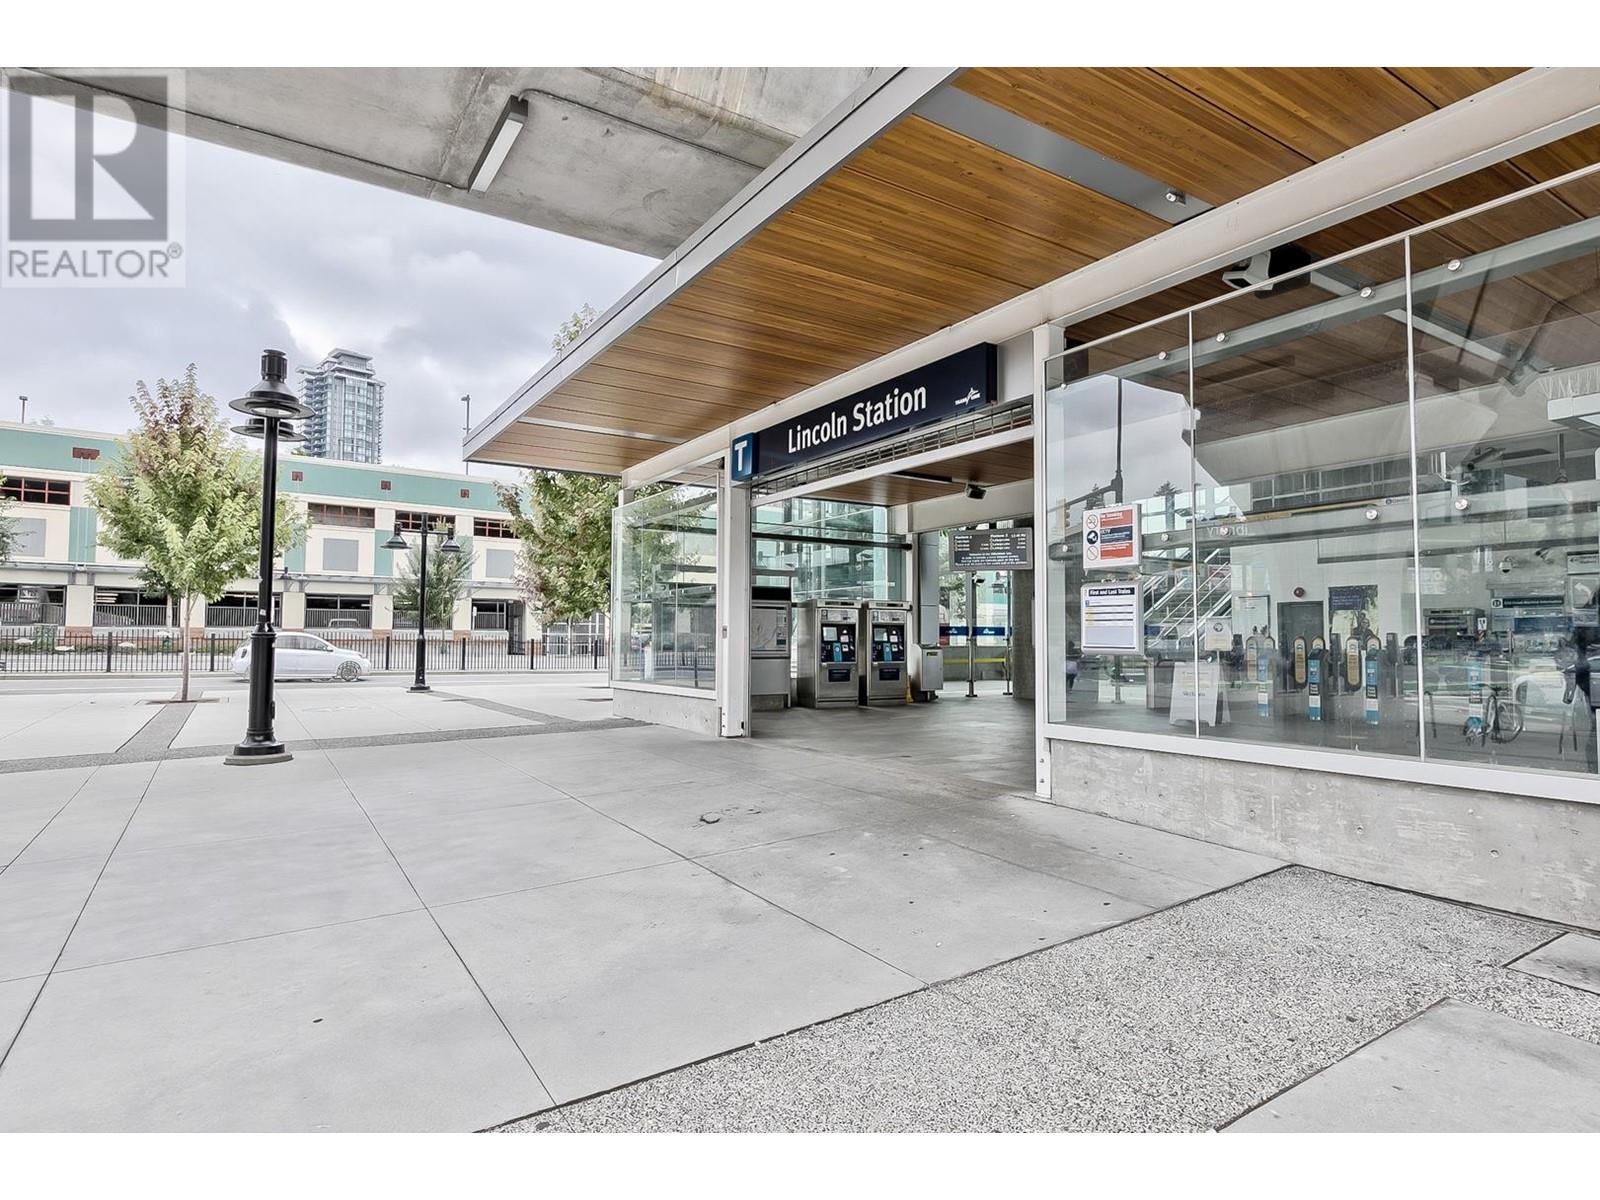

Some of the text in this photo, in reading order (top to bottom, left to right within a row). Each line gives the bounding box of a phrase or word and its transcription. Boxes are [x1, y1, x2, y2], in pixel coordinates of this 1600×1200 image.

[787, 413, 848, 454] Lincoln
[852, 385, 927, 433] Station
[734, 440, 749, 472] T
